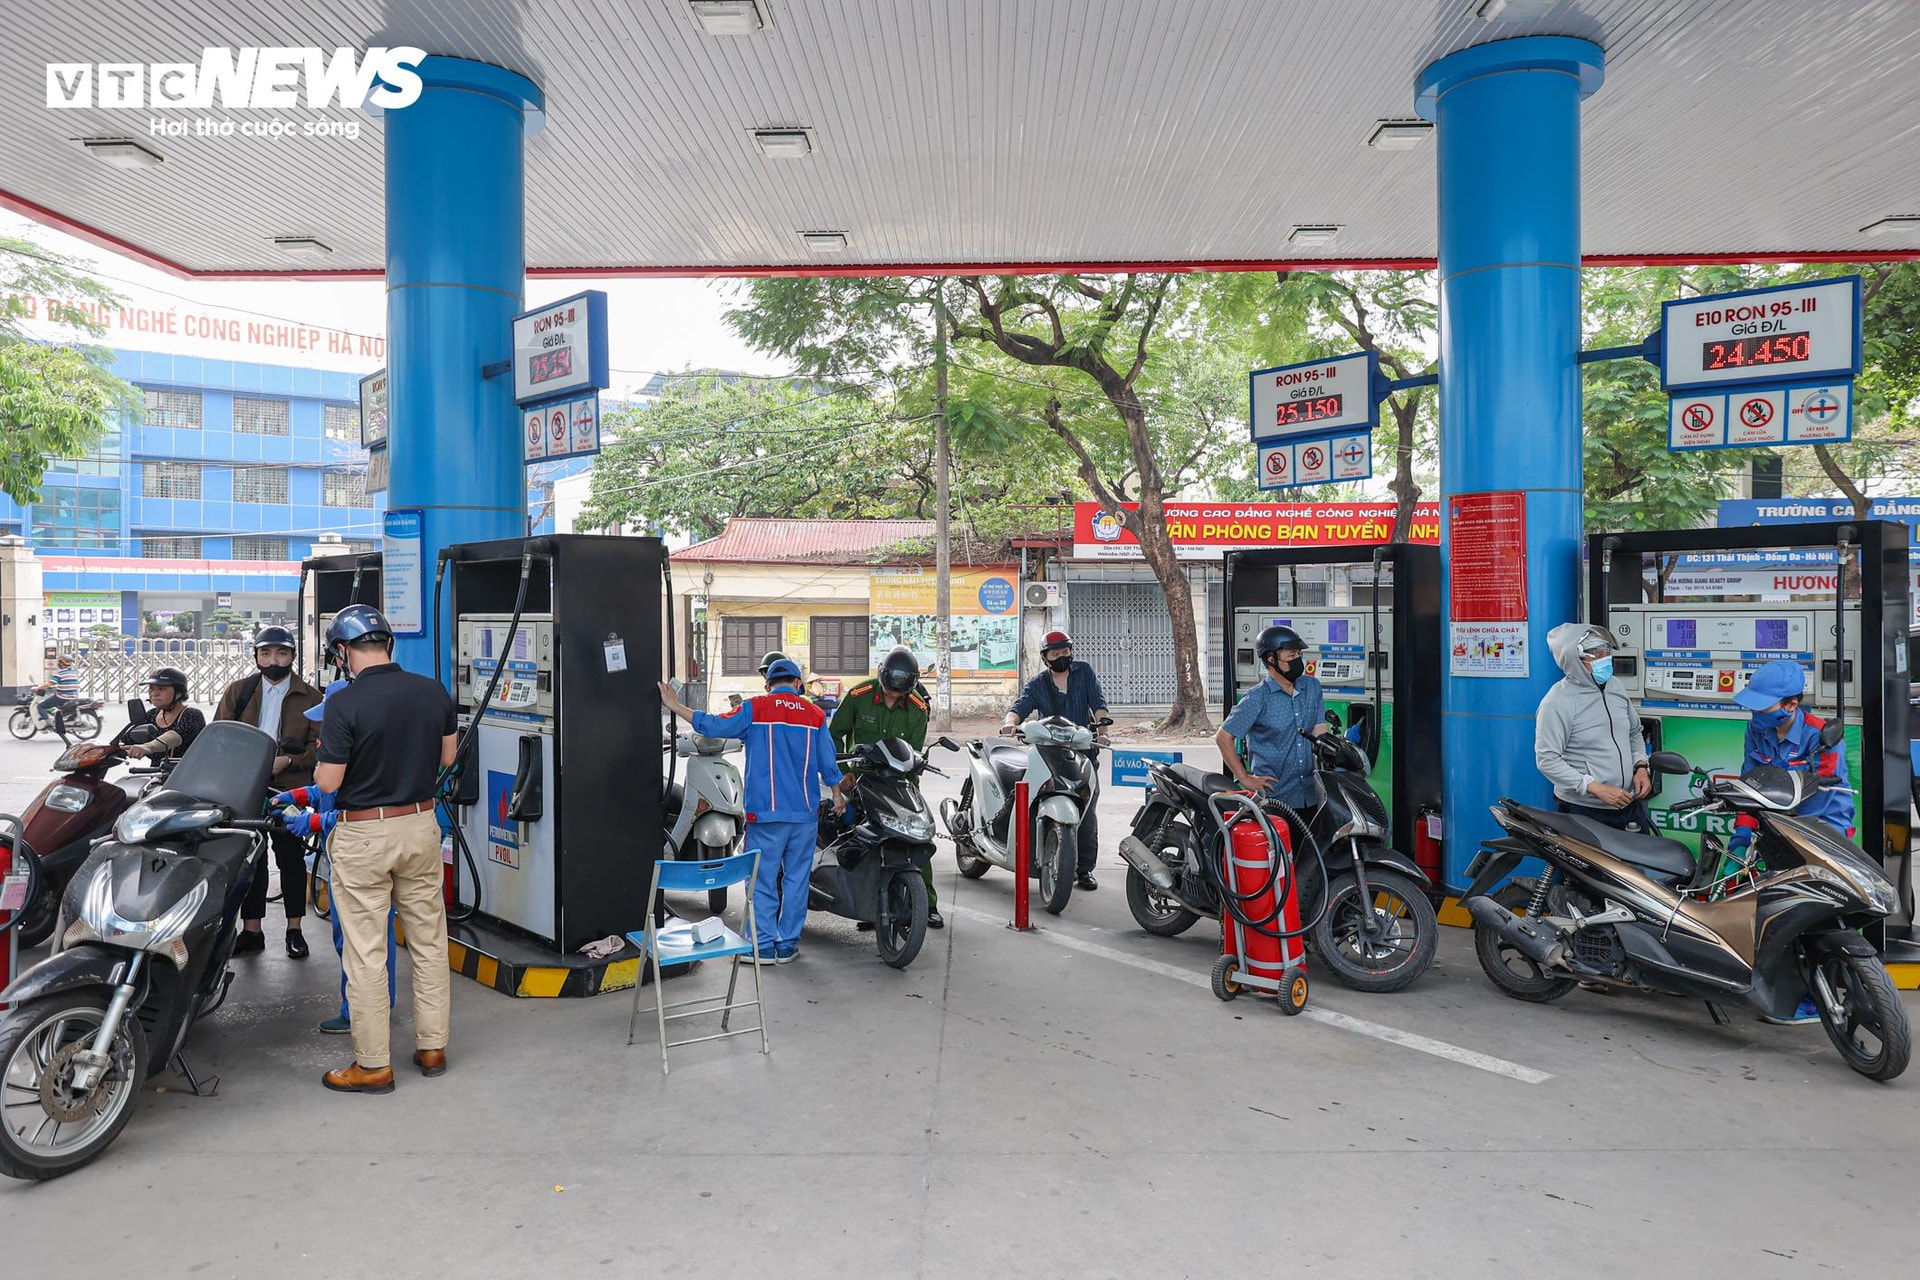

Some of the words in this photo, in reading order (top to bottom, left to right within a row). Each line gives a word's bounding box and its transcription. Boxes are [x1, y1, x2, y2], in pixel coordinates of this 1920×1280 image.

[1696, 310, 1721, 327] E10
[1725, 304, 1766, 323] RON
[0, 292, 37, 319] AO
[120, 306, 177, 335] NGHỀ
[185, 311, 241, 343] CÔNG
[248, 322, 321, 354] NGHIỆP
[329, 328, 352, 355] HÀ
[360, 333, 385, 363] NỘ
[533, 316, 553, 334] RON
[1731, 322, 1757, 336] Giá
[1761, 320, 1787, 332] Đ/L
[542, 334, 554, 349] Giá
[554, 332, 566, 346] Đ/L
[1709, 335, 1811, 370] 24.450
[1275, 372, 1302, 388] RON
[1290, 386, 1307, 400] Giá
[1308, 385, 1325, 397] Đ/L
[1277, 398, 1338, 424] 25.150
[1164, 508, 1199, 518] ƯỜNG
[1202, 509, 1231, 518] CAO
[1235, 505, 1273, 518] ĐẲNG
[1276, 505, 1313, 518] NGHỀ
[1316, 506, 1354, 518] CÔNG
[1359, 506, 1398, 519] NGHIỆ
[1412, 505, 1429, 517] HÀ
[1432, 508, 1440, 517] N
[1756, 504, 1827, 518] TRƯỜNG
[1832, 506, 1856, 516] CA
[1202, 520, 1272, 540] PHÒNG
[1277, 523, 1319, 540] BAN
[1324, 519, 1388, 540] TUYỂN
[1408, 523, 1439, 539] INH
[1702, 554, 1715, 562] 131
[1717, 553, 1735, 562] Thái
[1737, 553, 1760, 563] Thịnh
[1765, 552, 1787, 562] Đống
[1789, 553, 1800, 561] Đa
[1805, 552, 1817, 560] Hà
[1818, 552, 1833, 562] Nội
[775, 699, 806, 711] PVOIL
[1114, 756, 1126, 768] LỐI
[1126, 757, 1142, 769] VÀO
[1650, 811, 1698, 830] E10
[1705, 814, 1737, 834] RO
[495, 844, 512, 864] PVOIL
[1821, 885, 1849, 902] HONDA
